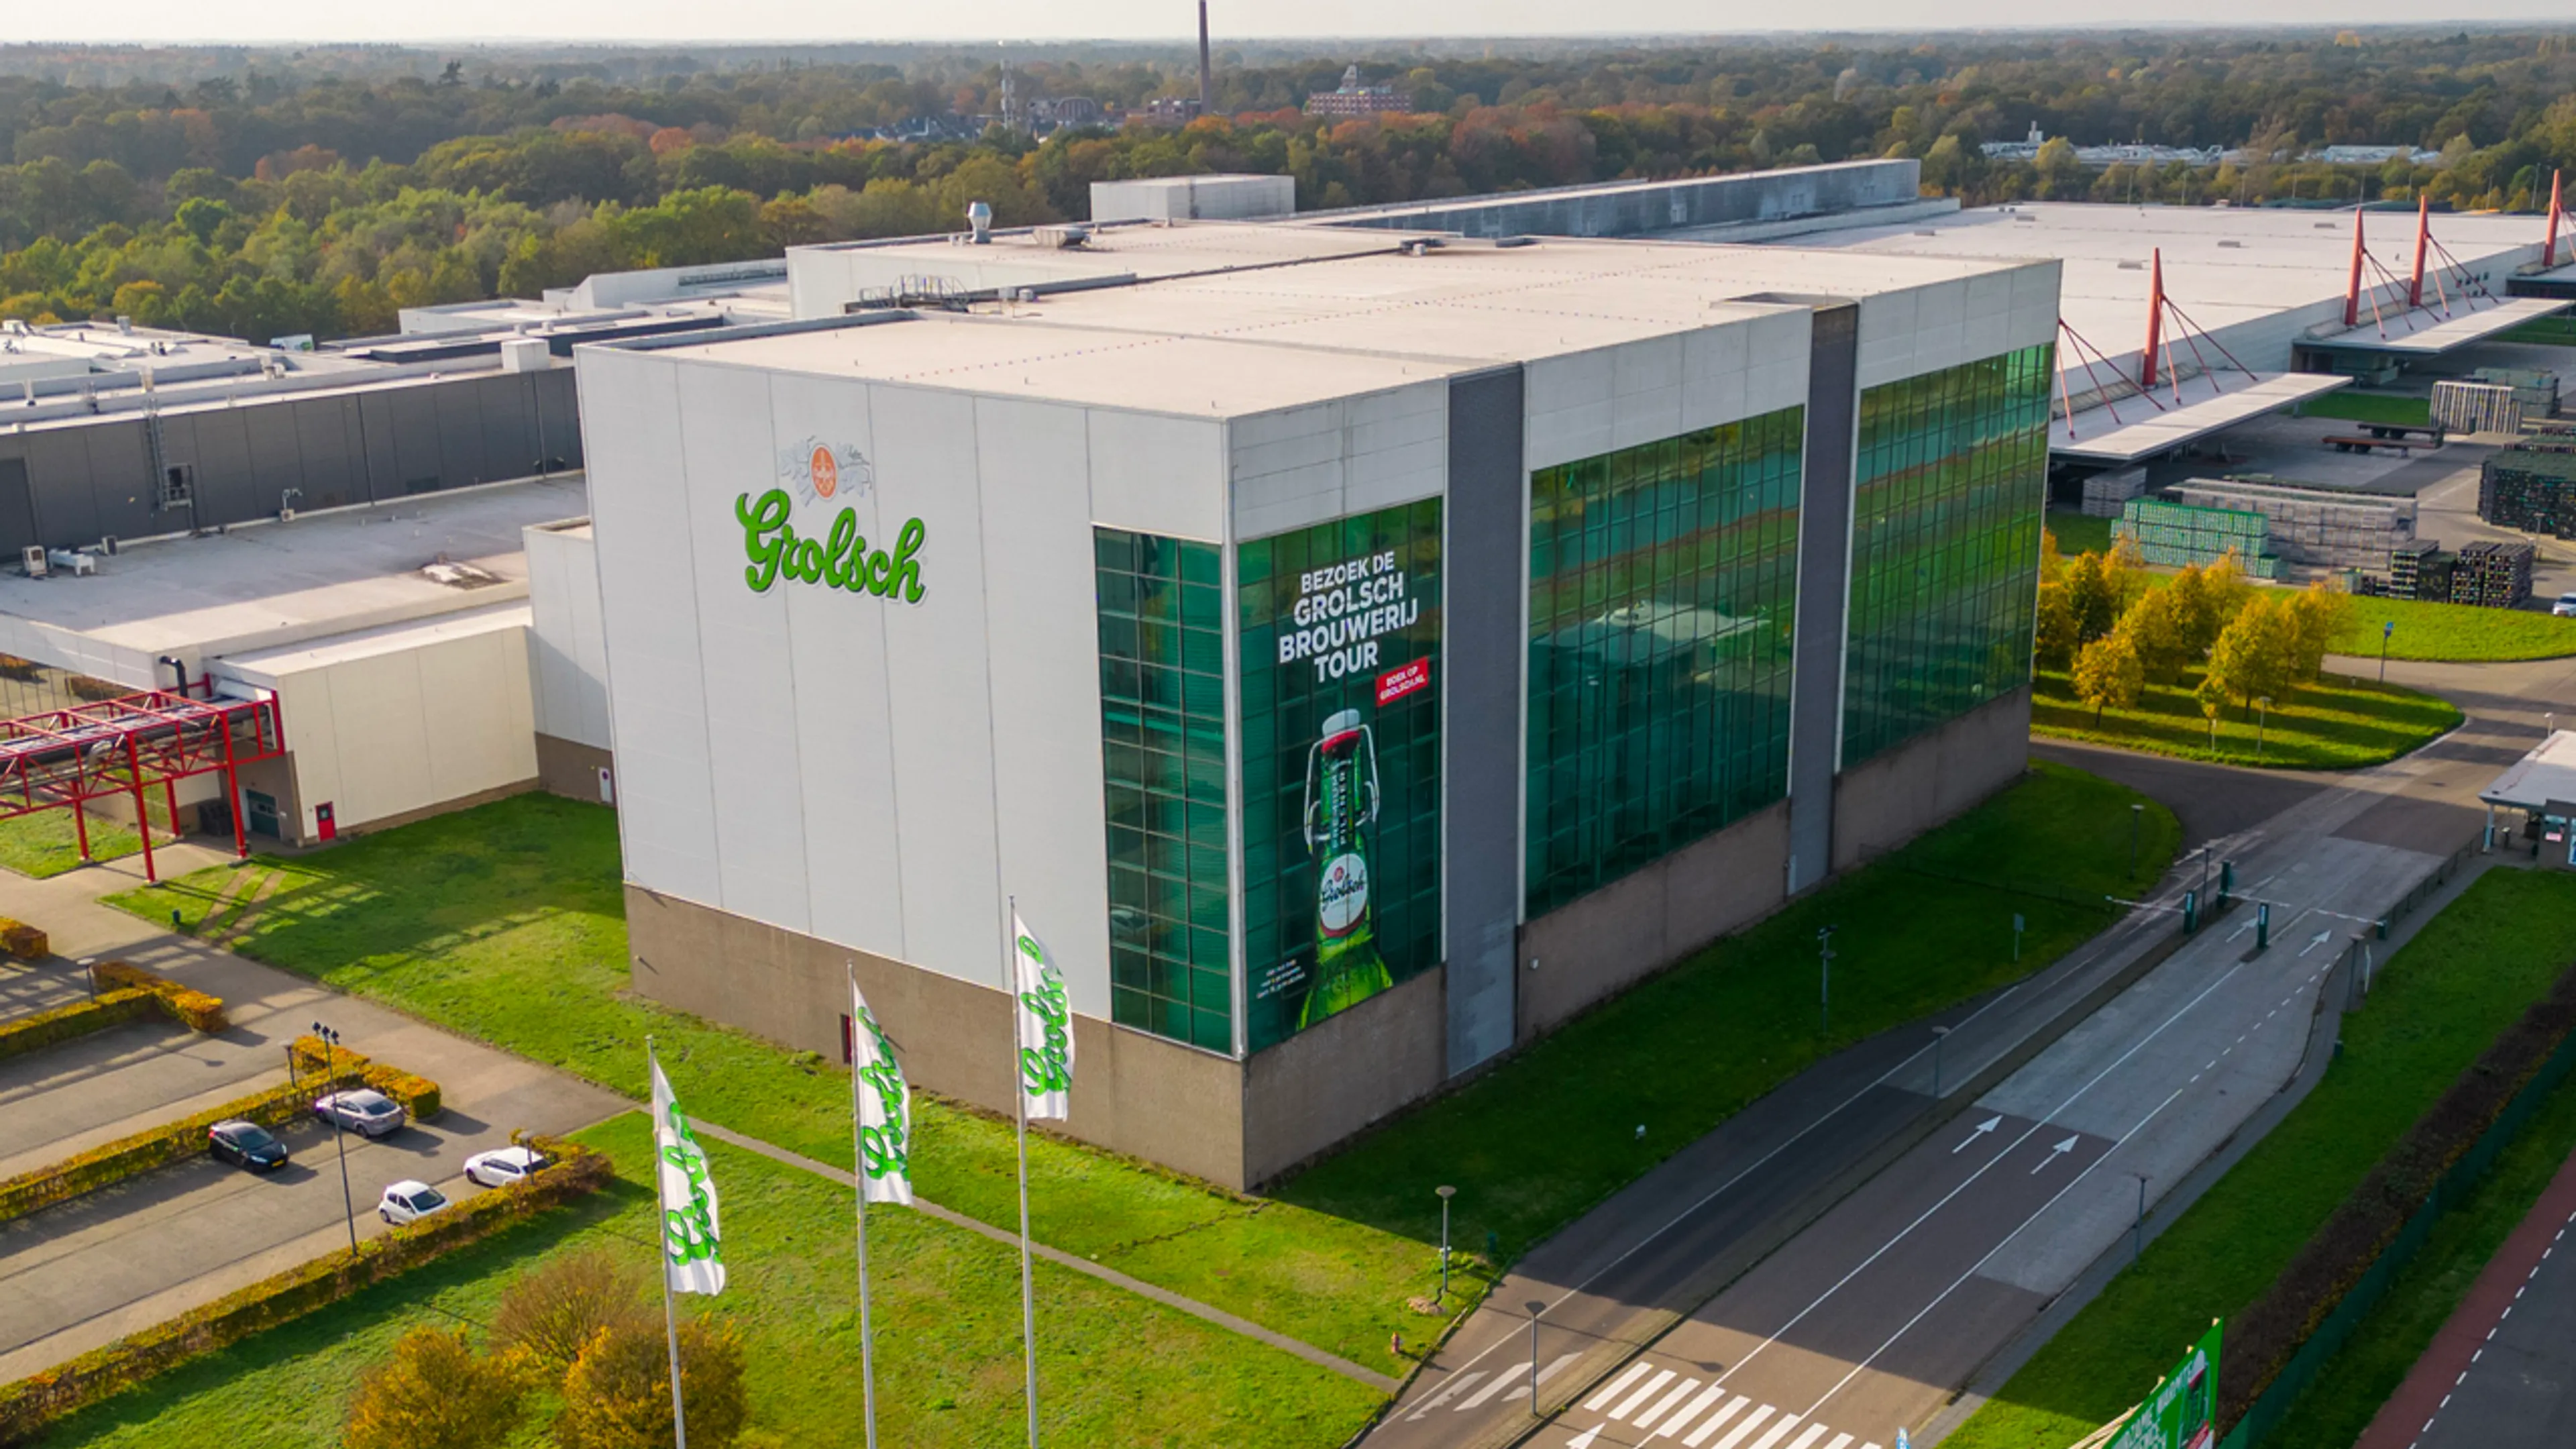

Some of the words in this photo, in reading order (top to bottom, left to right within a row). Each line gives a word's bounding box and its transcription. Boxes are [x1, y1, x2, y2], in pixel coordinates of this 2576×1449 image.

[735, 488, 926, 604] Grolsch
[1301, 557, 1370, 594] BEZOEK
[1372, 551, 1395, 575] DE
[1293, 572, 1404, 627] GROLSCH
[1279, 597, 1418, 663] BROUWERIJ
[1313, 640, 1379, 684] TOUR
[1321, 869, 1365, 912] Grolsch
